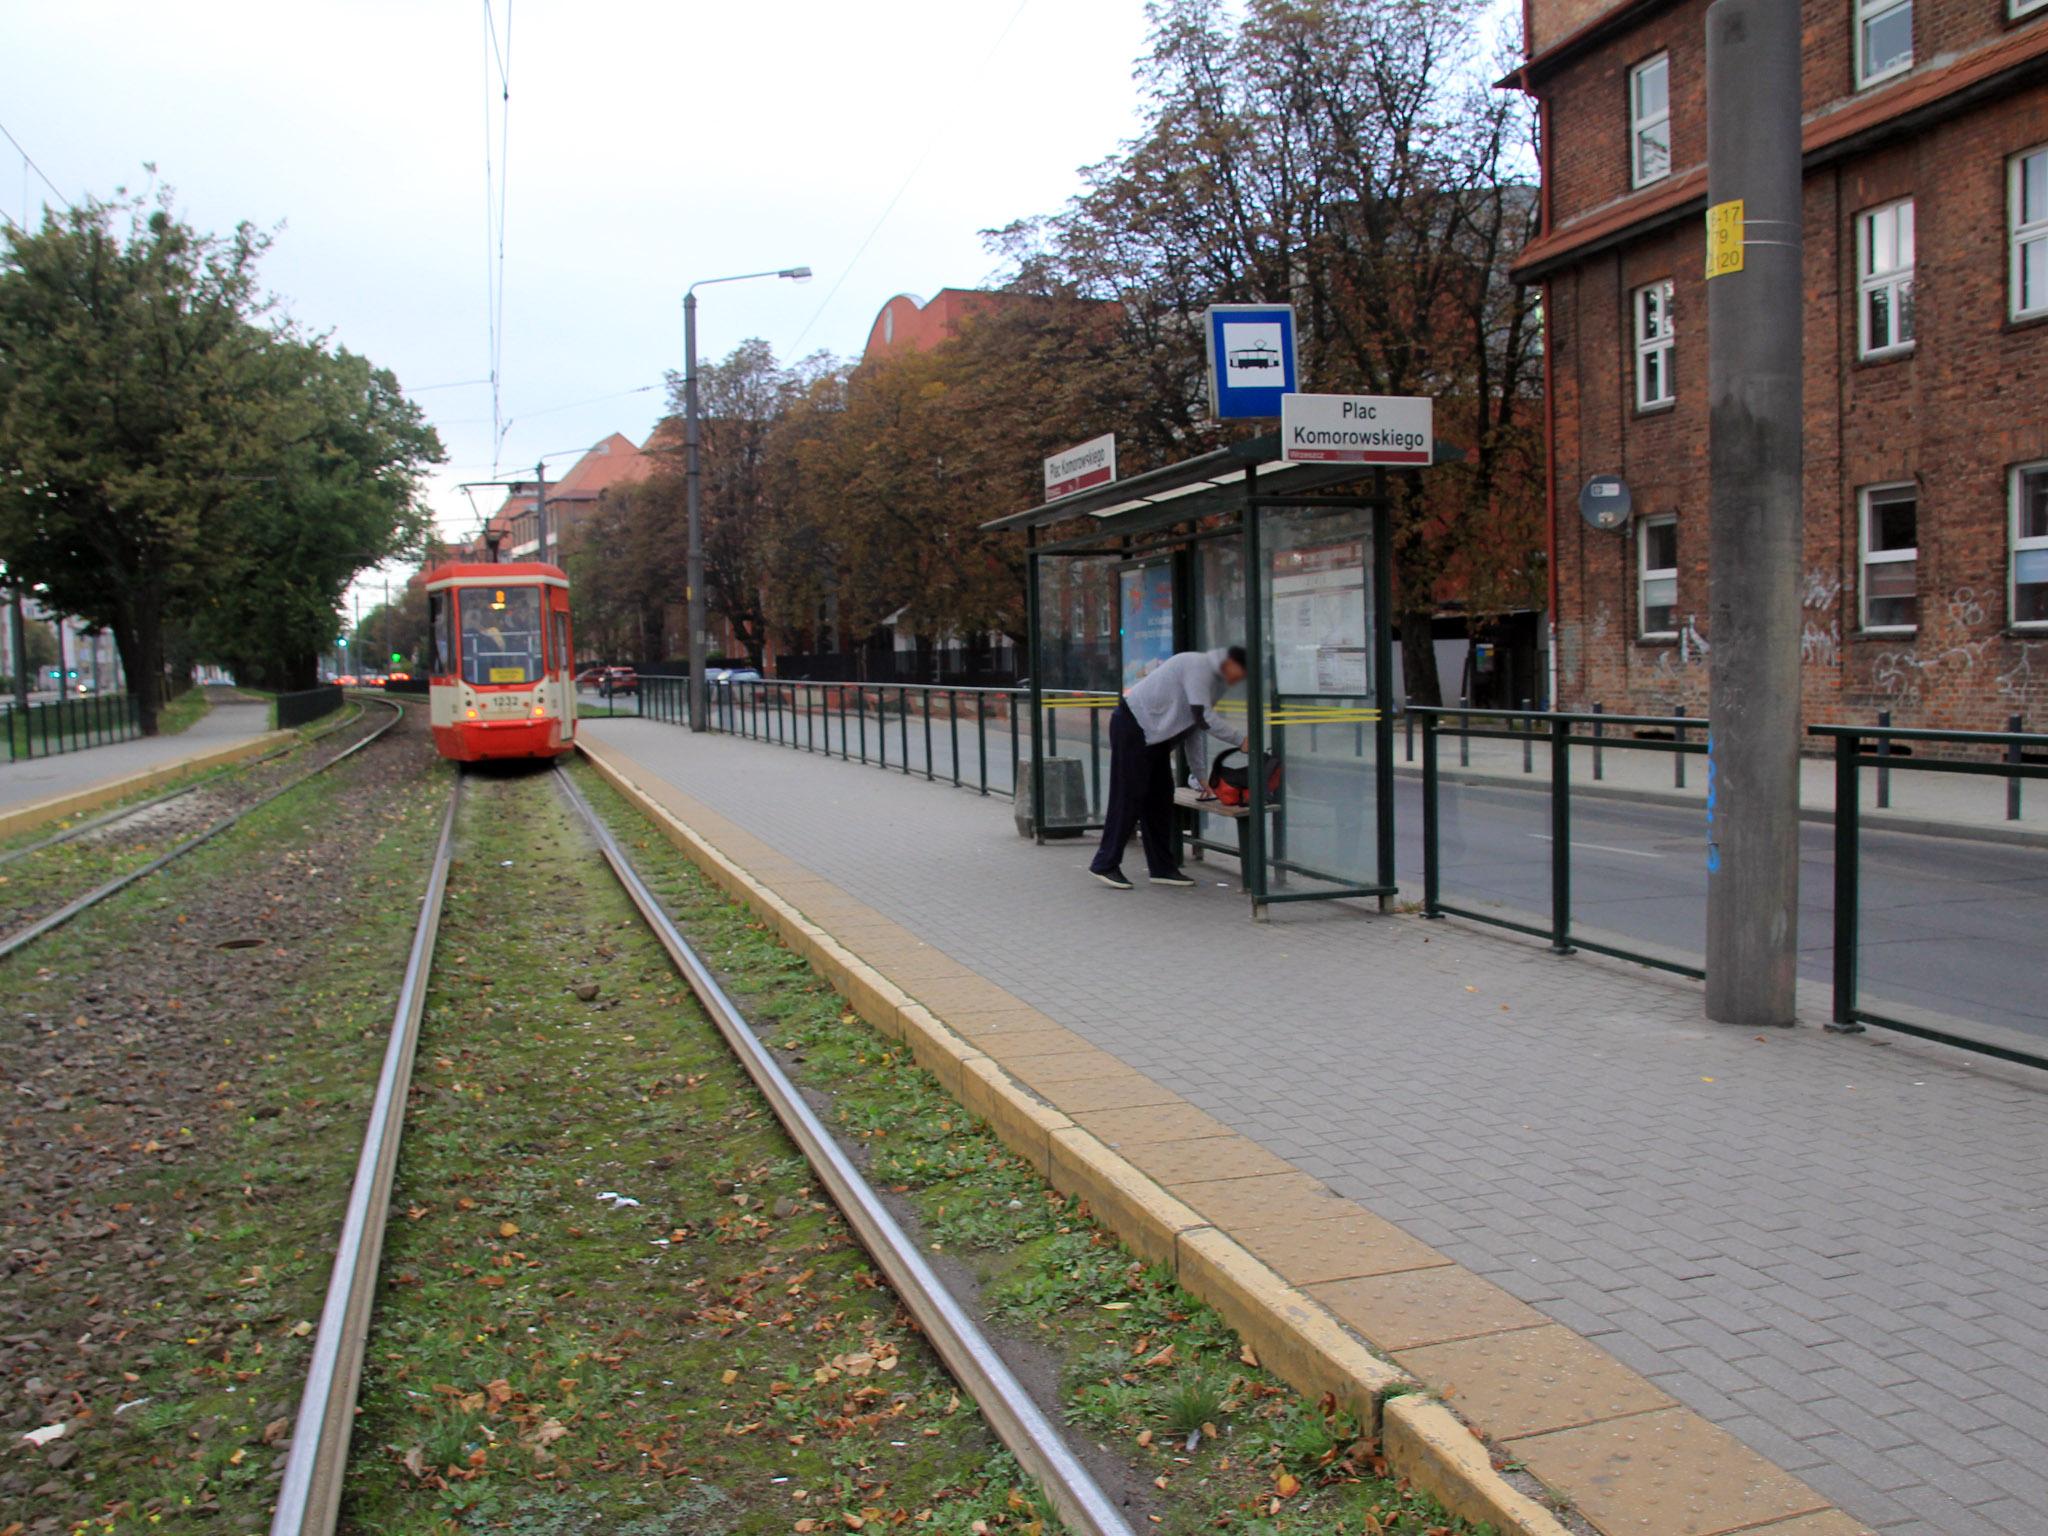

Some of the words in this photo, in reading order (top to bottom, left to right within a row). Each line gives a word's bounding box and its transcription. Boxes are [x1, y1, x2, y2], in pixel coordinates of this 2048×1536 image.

[1342, 401, 1377, 420] Plac
[1293, 425, 1424, 451] Komorowskiego
[1048, 463, 1061, 480] Plac
[1061, 446, 1105, 476] Komorowskiego
[493, 695, 519, 707] 1232
